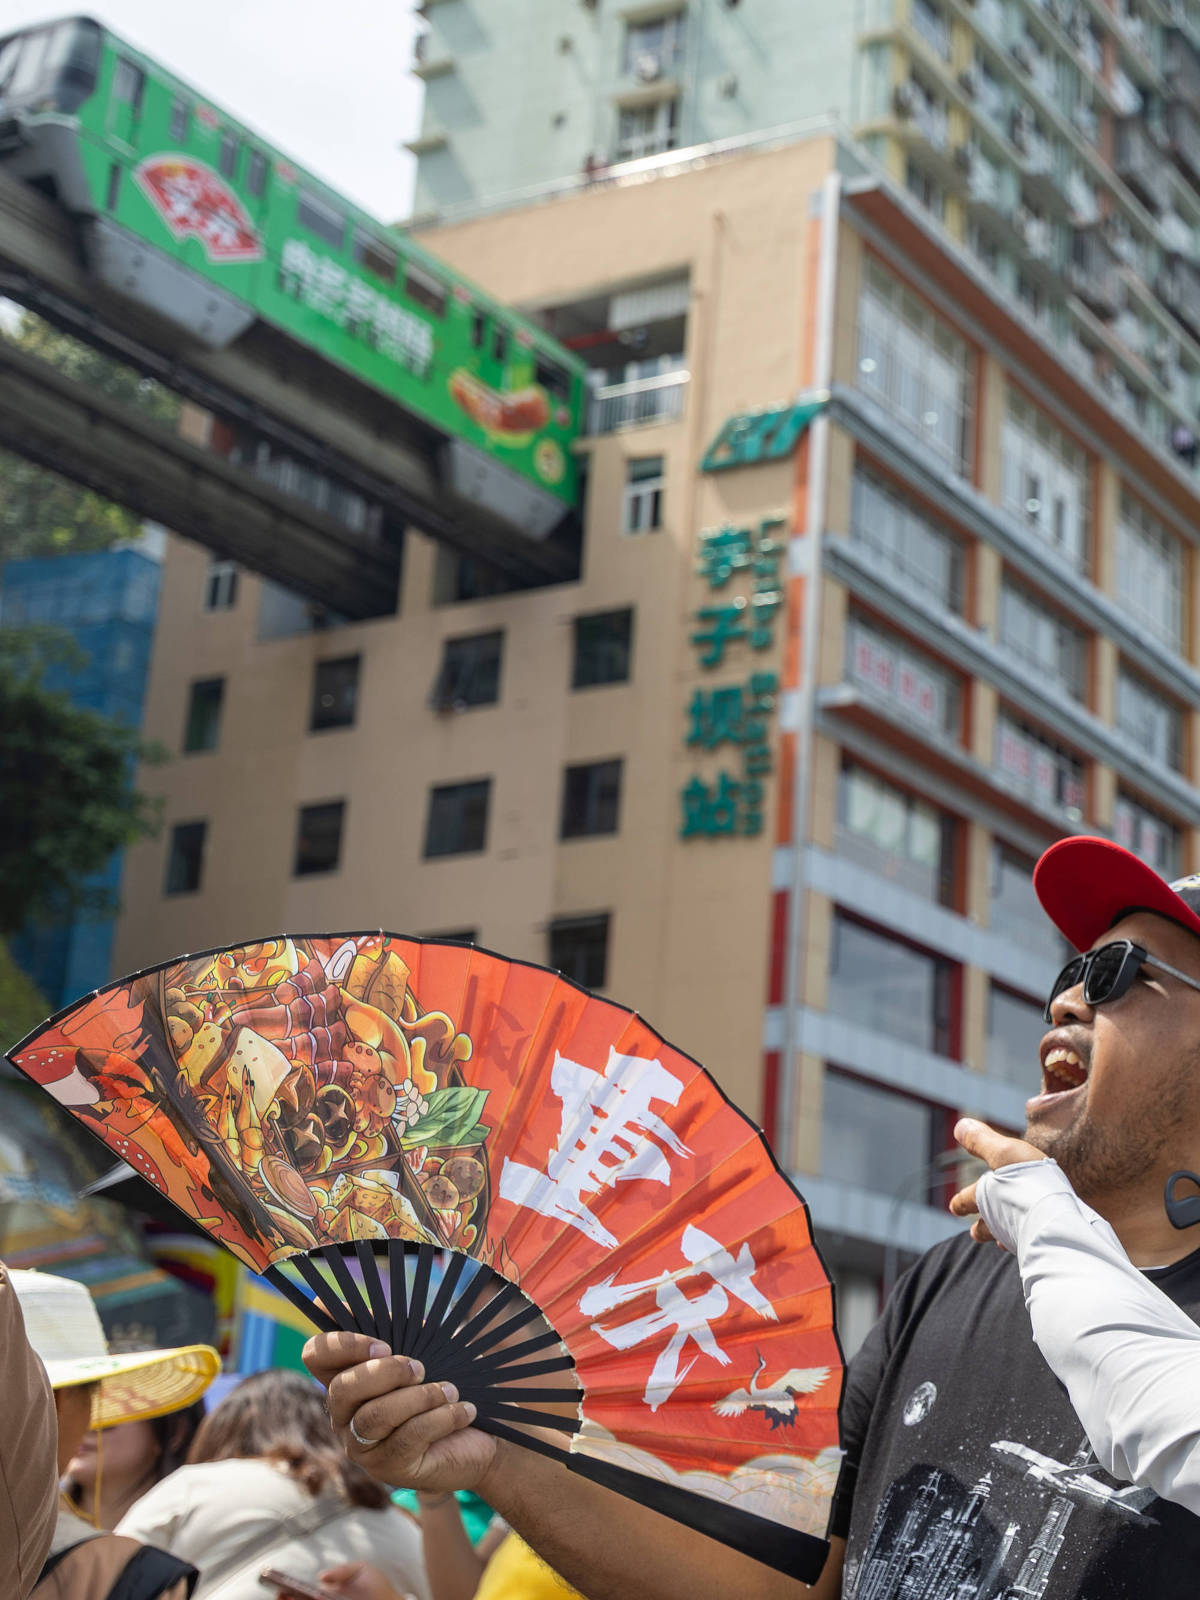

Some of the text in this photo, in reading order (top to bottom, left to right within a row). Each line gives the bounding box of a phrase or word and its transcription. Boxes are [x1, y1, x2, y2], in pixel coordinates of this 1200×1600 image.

[681, 524, 752, 838] 李子坝站
[499, 1045, 779, 1412] 重庆
